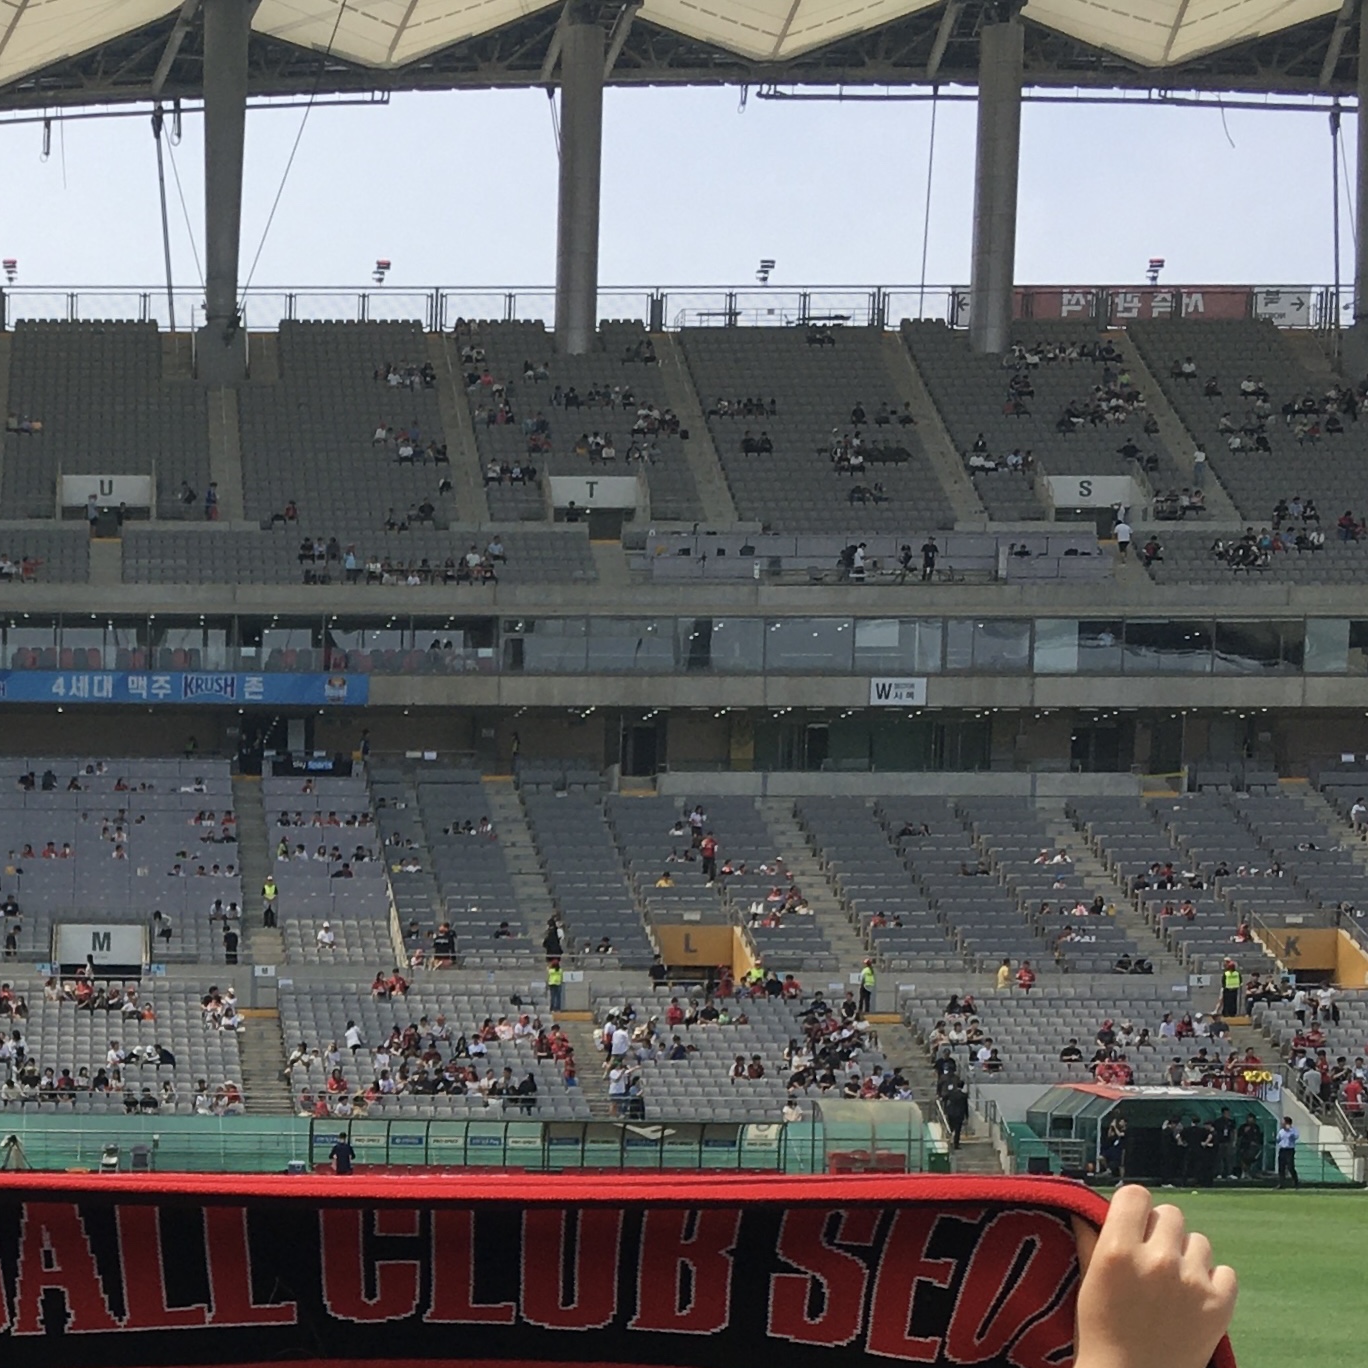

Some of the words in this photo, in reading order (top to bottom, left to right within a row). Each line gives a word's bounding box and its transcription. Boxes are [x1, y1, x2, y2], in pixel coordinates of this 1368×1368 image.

[99, 479, 113, 496] U
[585, 481, 599, 498] T
[1078, 480, 1093, 497] S
[127, 675, 172, 699] 맥주
[183, 675, 236, 698] KRUSH
[243, 676, 265, 700] 존
[875, 682, 893, 700] W
[91, 931, 112, 952] M
[683, 933, 698, 953] L
[1284, 935, 1302, 957] K
[318, 1206, 742, 1336] CLUB
